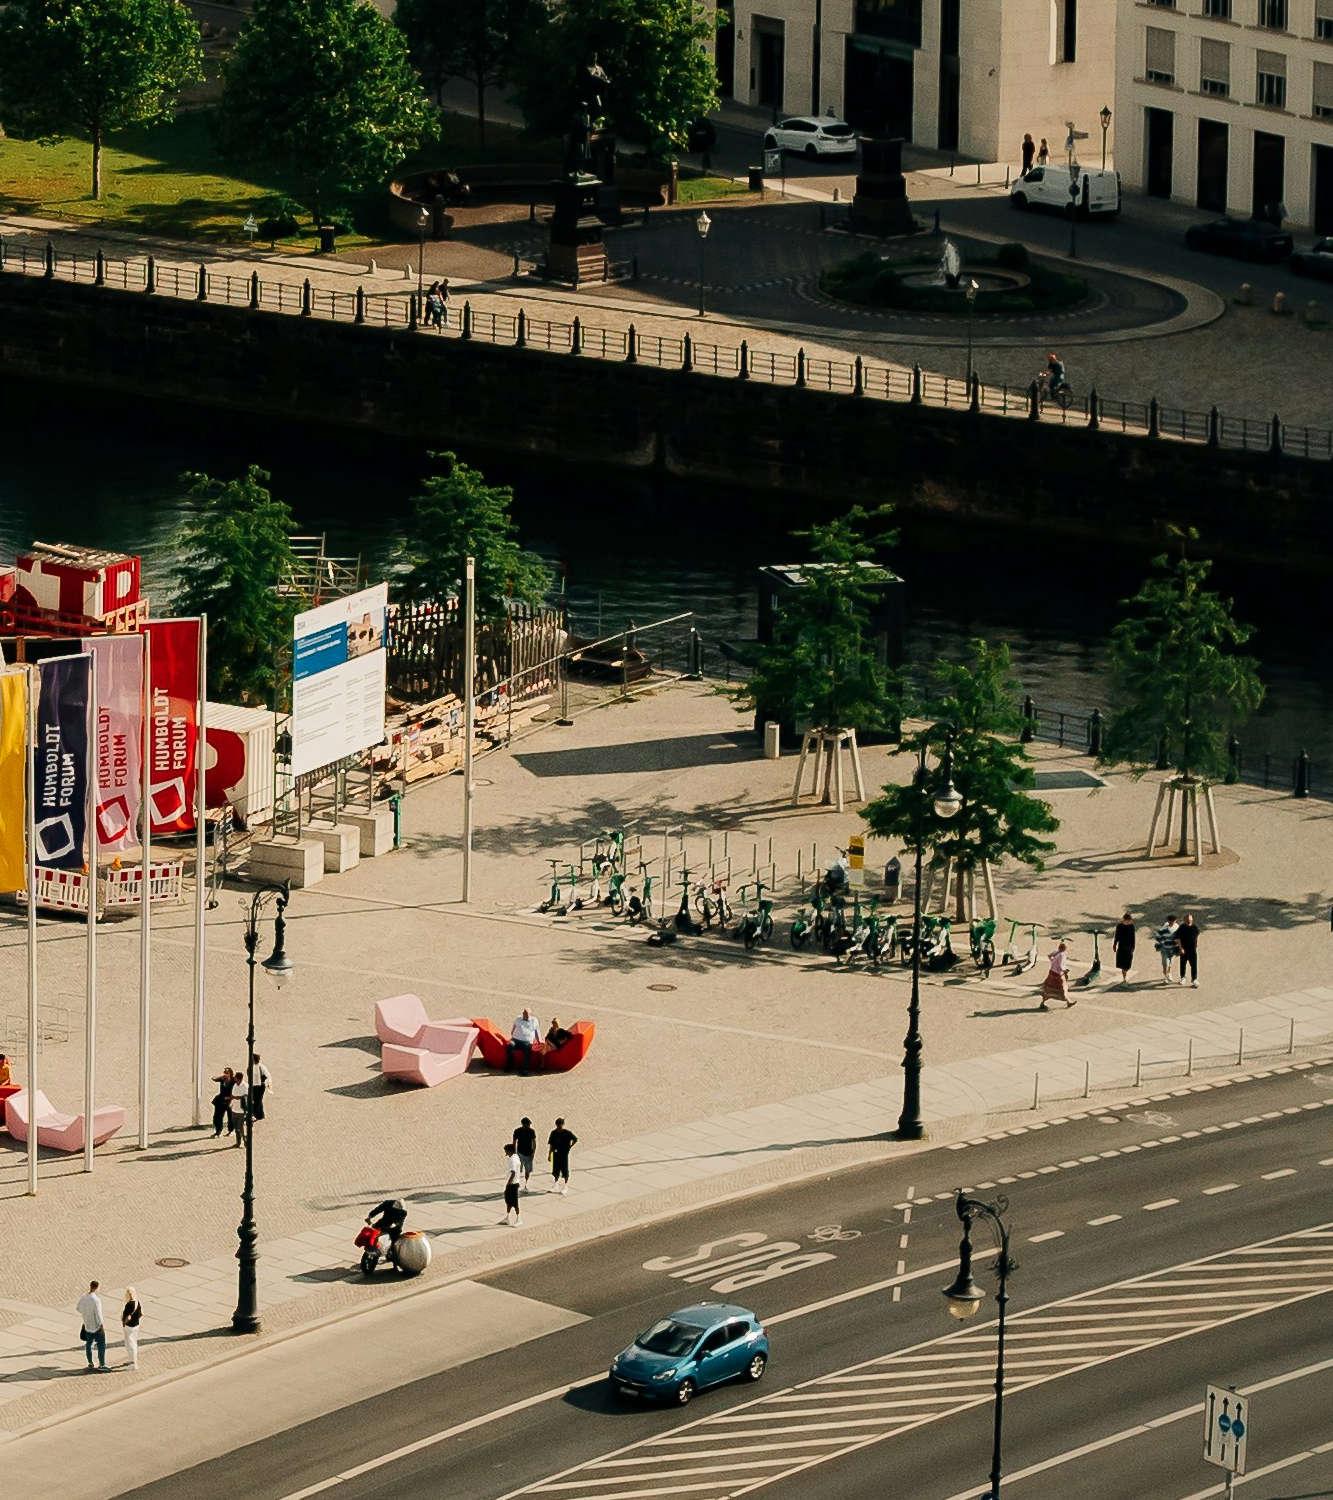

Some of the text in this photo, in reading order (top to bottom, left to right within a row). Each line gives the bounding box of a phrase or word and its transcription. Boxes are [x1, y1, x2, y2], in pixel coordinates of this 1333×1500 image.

[99, 706, 111, 789] HUMBOLDT
[154, 687, 170, 771] HUMBOLDT
[172, 716, 187, 770] FORUM
[42, 724, 61, 807] HUMBOLDT
[60, 753, 76, 807] FORUM
[113, 734, 127, 788] FORUM
[642, 1231, 838, 1294] BUS
